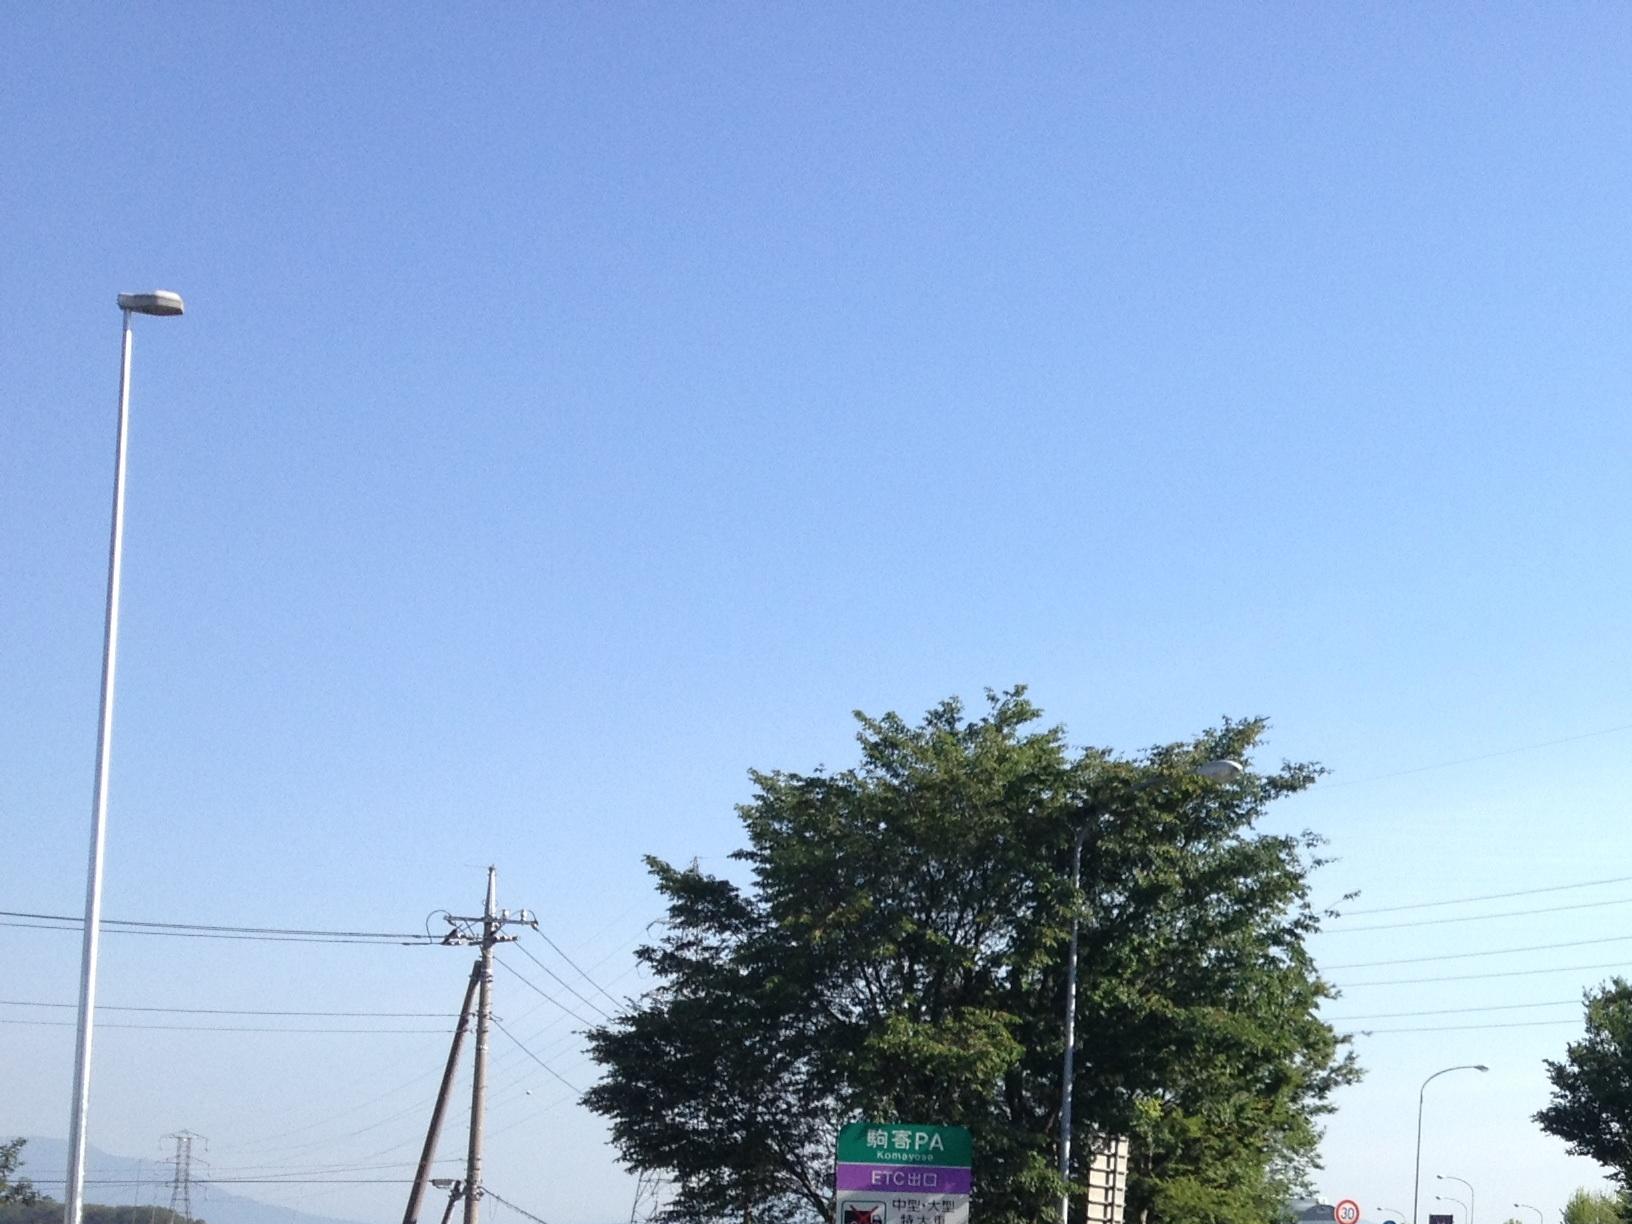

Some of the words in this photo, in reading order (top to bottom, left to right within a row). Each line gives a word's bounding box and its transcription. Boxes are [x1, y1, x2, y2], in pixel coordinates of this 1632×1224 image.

[866, 1128, 945, 1151] 駒寄PA
[871, 1169, 937, 1187] ETC出口
[1340, 1207, 1355, 1220] 30
